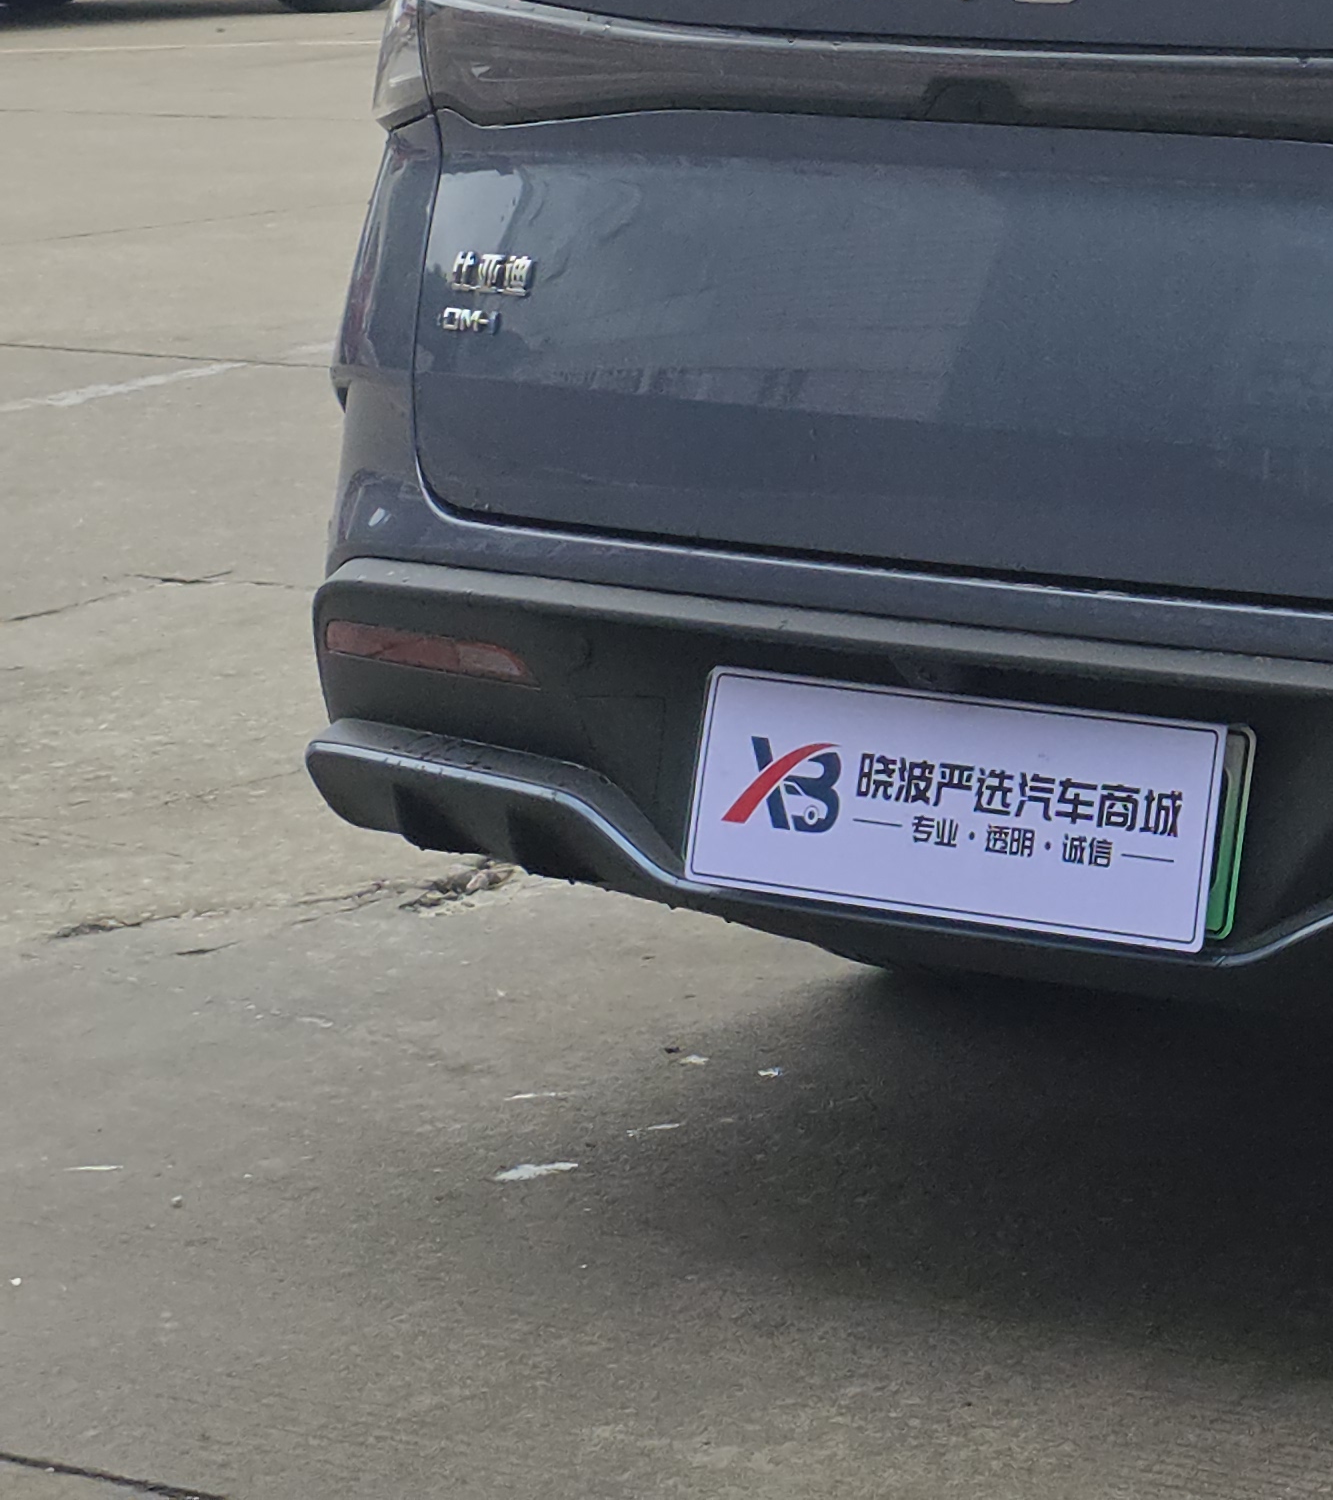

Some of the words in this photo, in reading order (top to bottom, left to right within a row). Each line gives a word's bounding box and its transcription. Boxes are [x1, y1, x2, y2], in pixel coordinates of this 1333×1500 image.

[451, 251, 534, 297] 比亚迪
[857, 752, 1183, 836] 晓波严选汽车商城
